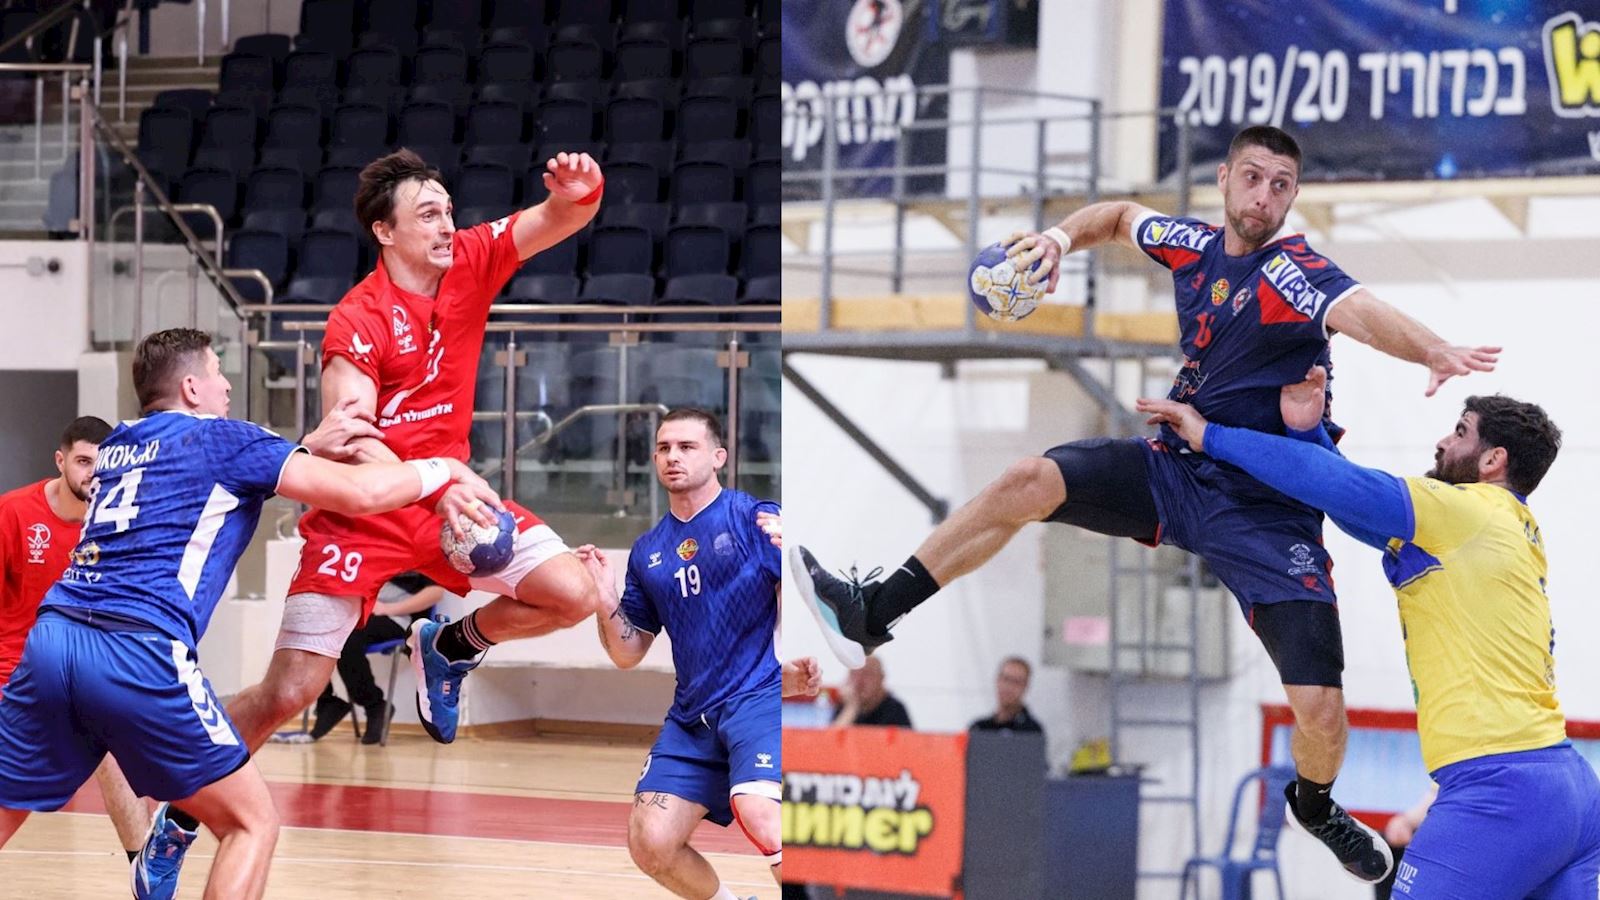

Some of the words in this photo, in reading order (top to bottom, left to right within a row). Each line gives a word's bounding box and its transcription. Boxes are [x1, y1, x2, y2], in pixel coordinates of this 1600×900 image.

[1172, 44, 1349, 130] 2019/20
[1358, 47, 1527, 119] בכדוריד
[317, 544, 363, 583] 29
[674, 564, 701, 598] 19
